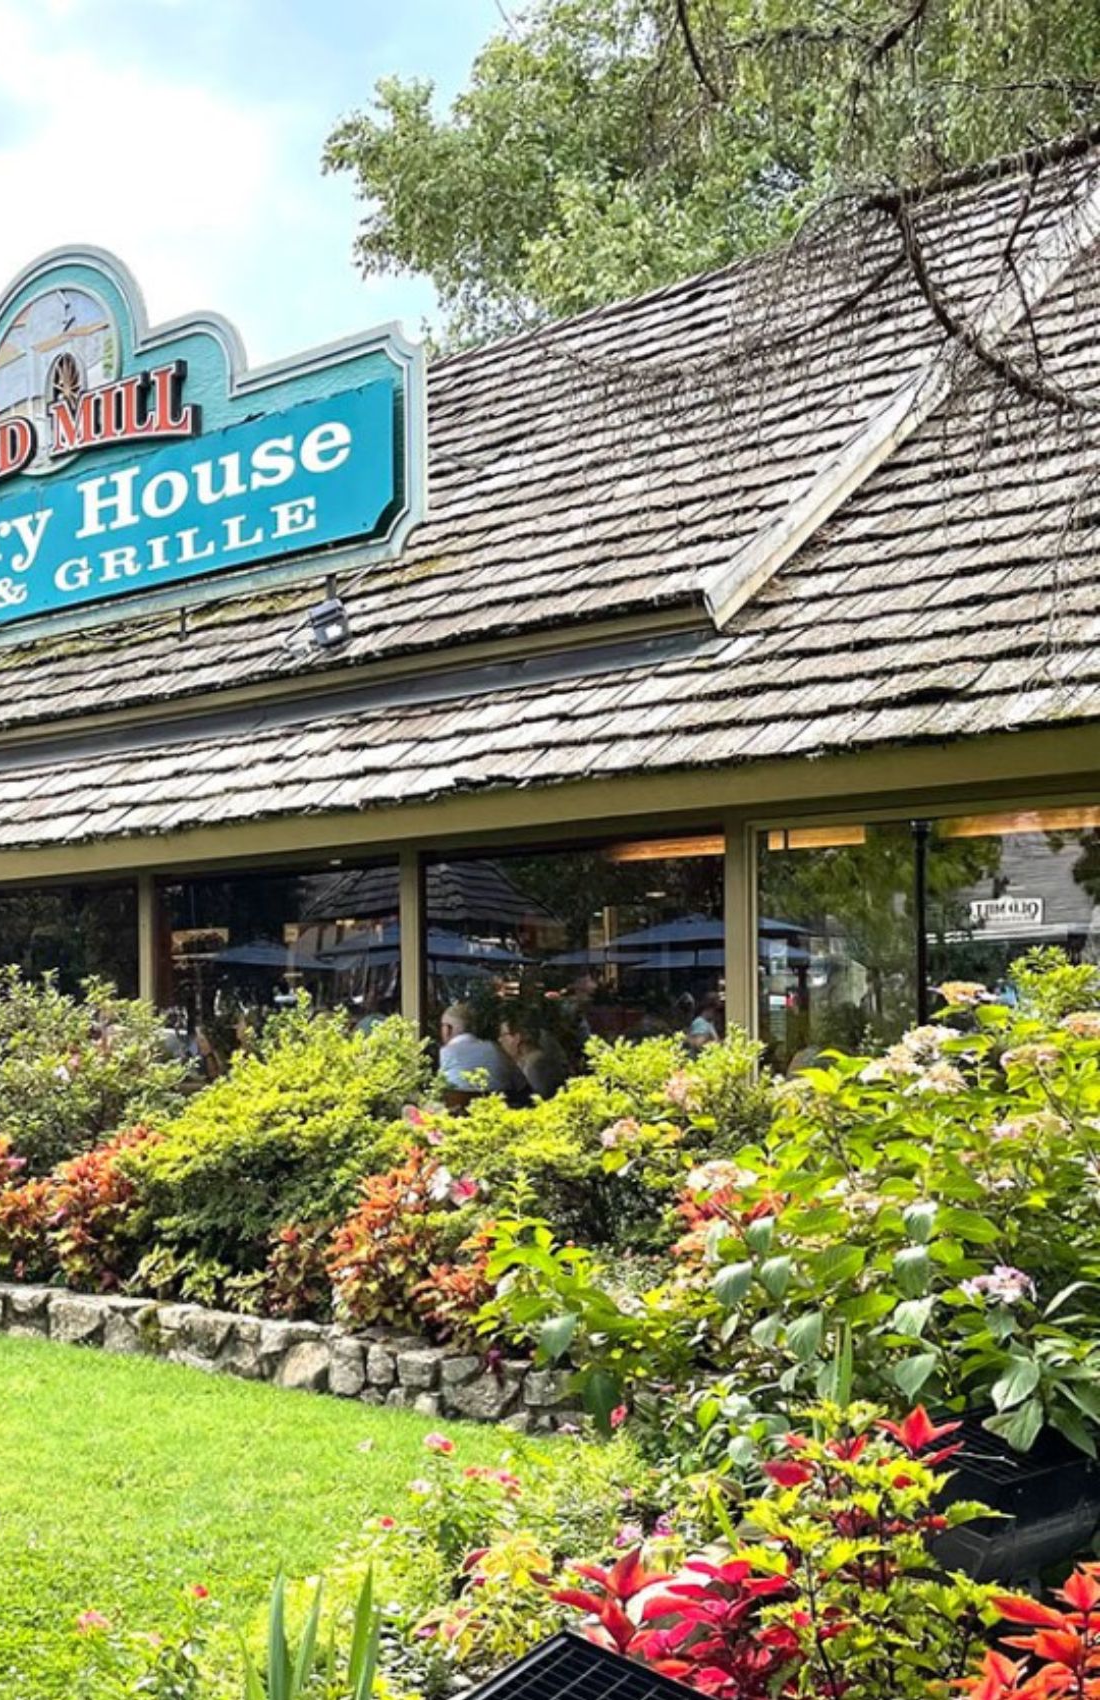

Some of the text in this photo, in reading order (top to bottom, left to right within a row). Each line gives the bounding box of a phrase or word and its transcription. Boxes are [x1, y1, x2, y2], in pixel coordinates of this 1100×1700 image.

[50, 364, 195, 455] MILL
[76, 421, 352, 539] House
[55, 497, 317, 592] GRILLE
